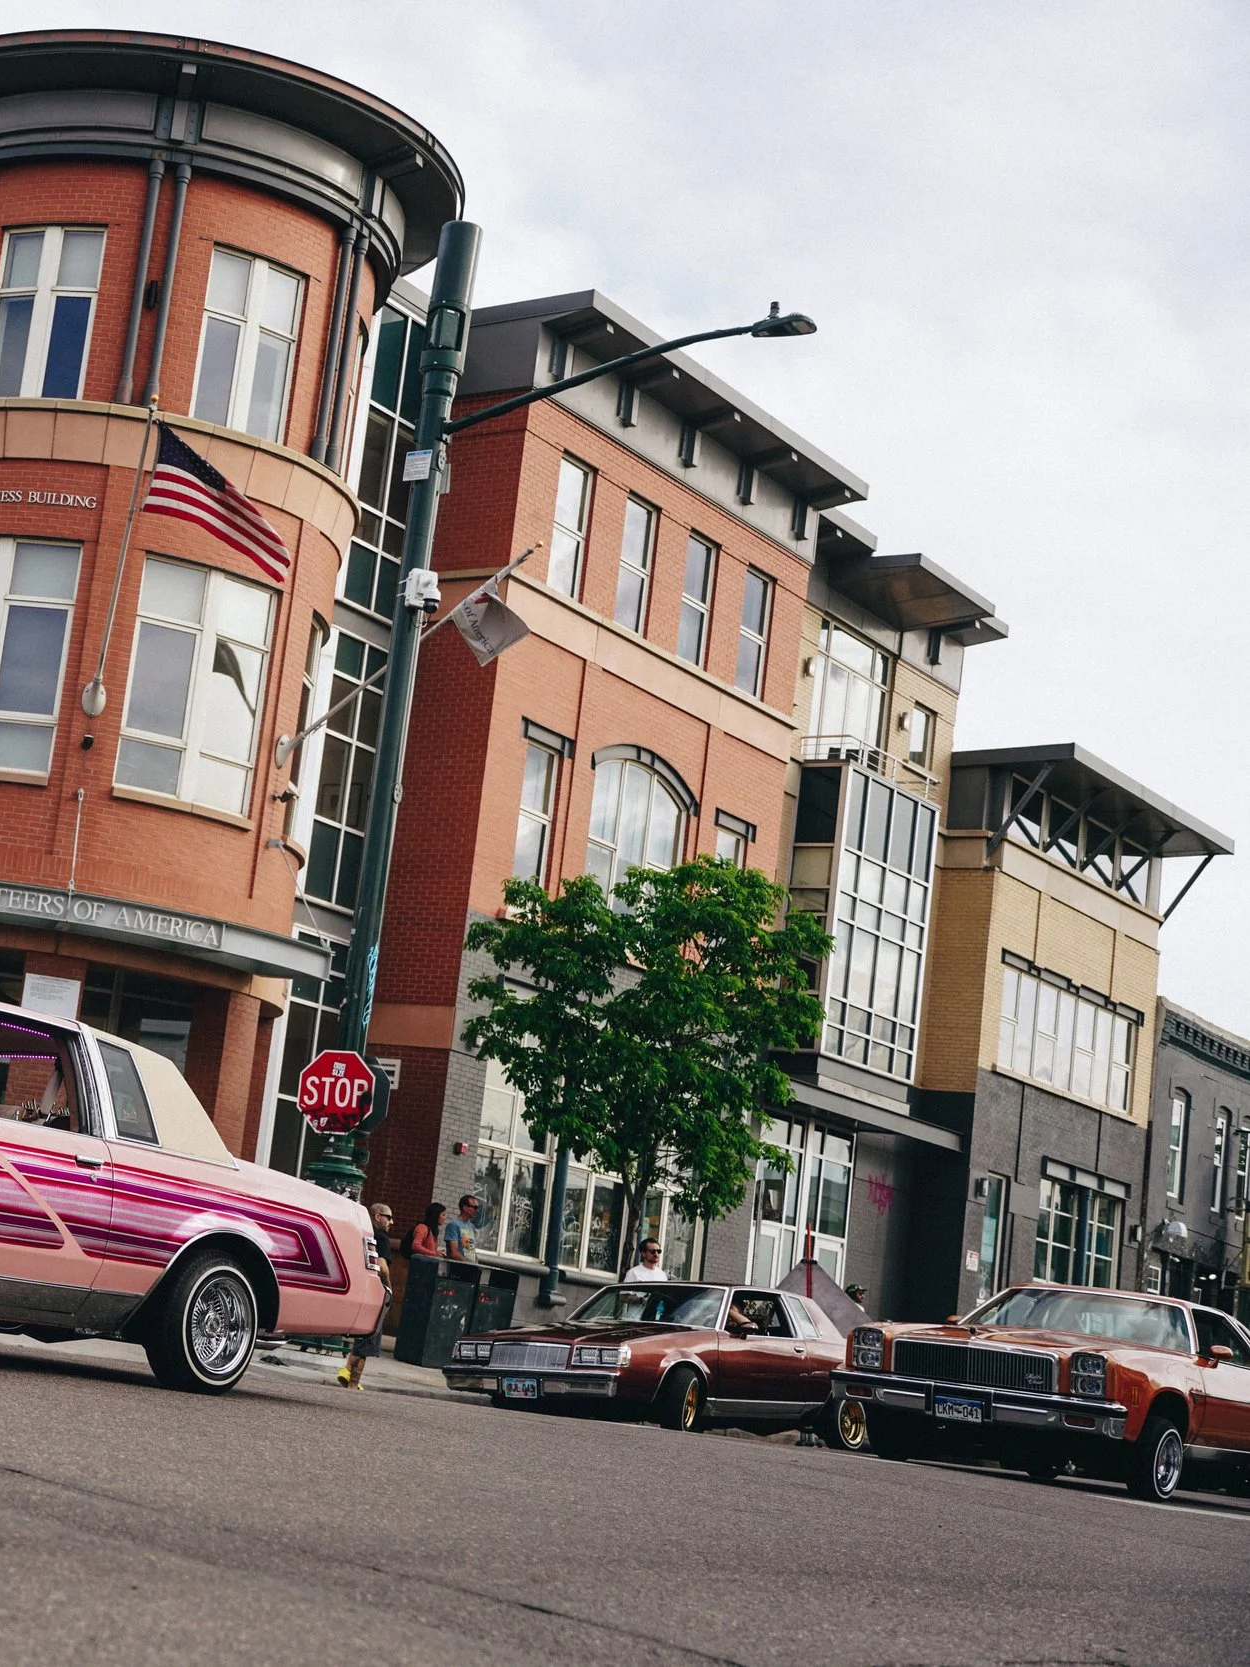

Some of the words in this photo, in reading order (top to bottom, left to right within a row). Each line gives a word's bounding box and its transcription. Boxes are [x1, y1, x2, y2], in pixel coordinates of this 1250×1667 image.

[28, 491, 97, 509] BUILDING
[73, 900, 106, 921] OF
[114, 907, 220, 946] AMERICA
[303, 1076, 368, 1107] STOP
